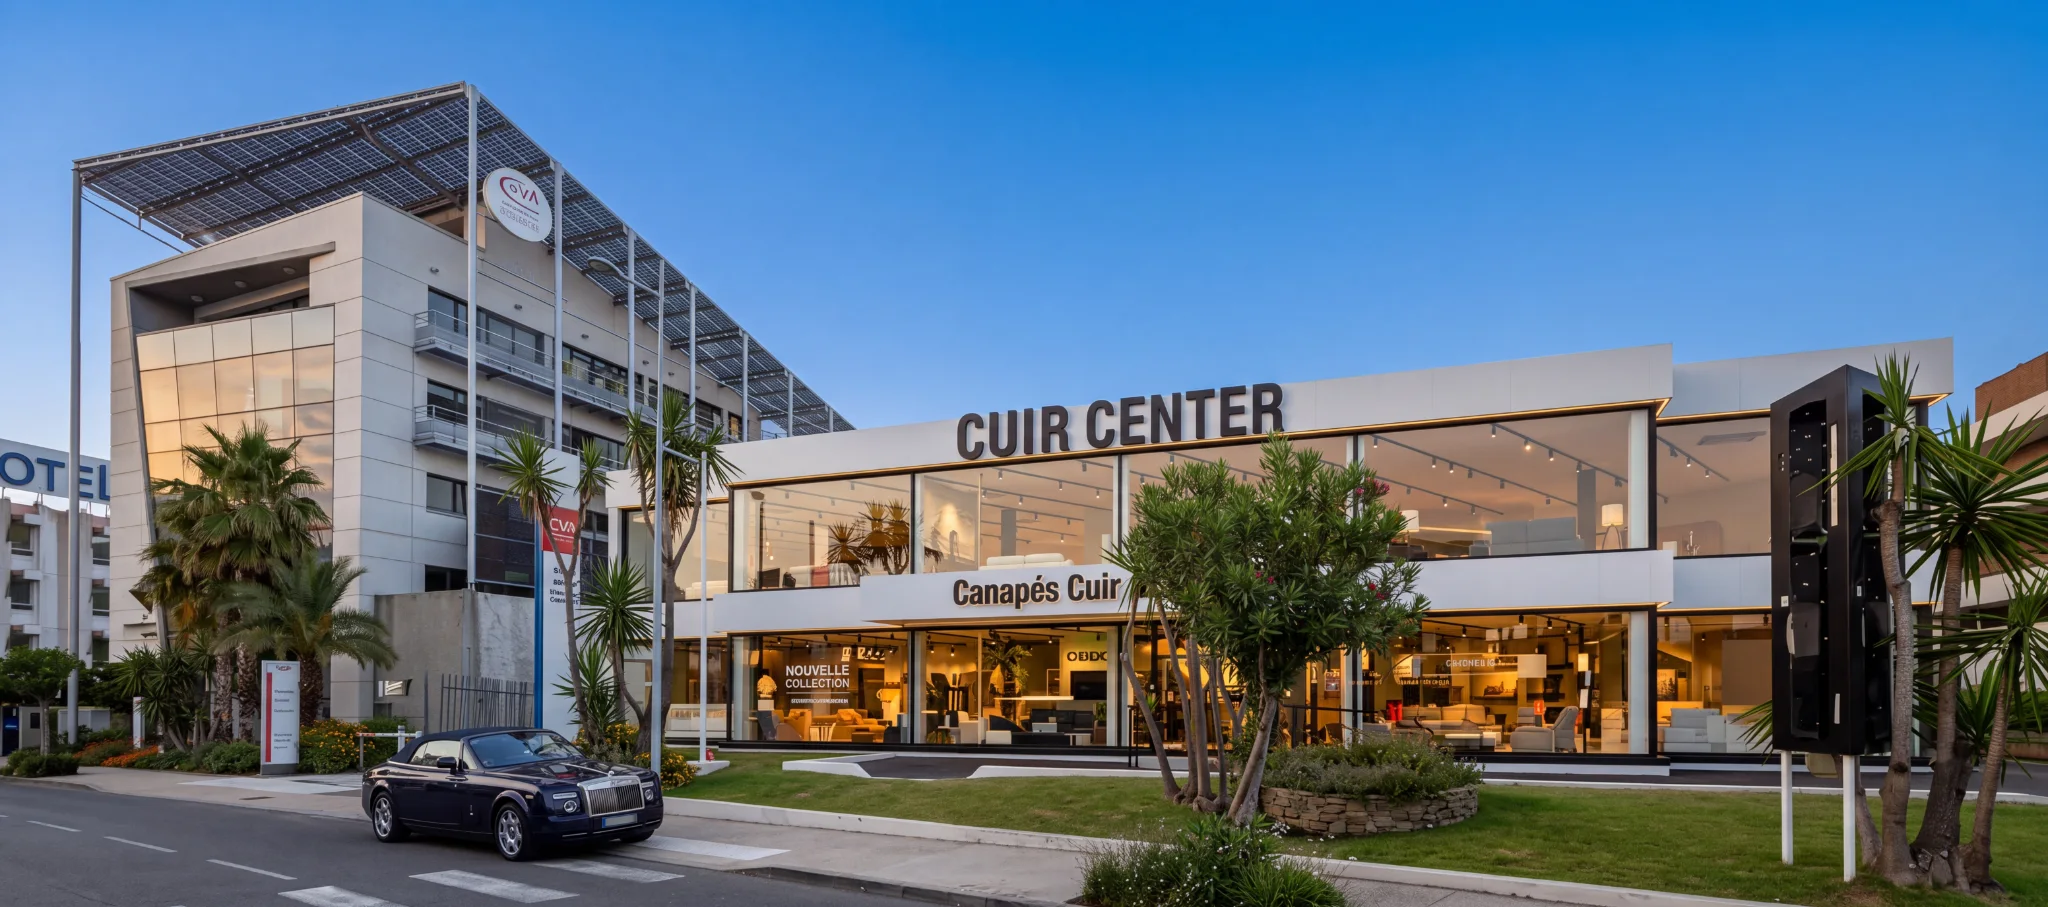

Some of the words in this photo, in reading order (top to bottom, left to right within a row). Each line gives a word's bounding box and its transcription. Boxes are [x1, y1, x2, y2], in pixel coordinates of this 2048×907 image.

[957, 405, 1070, 460] CUIR
[1086, 382, 1284, 449] CENTER
[953, 574, 1060, 610] Canapés
[1067, 572, 1122, 601] Cuir
[785, 665, 850, 676] NOUVELLE
[785, 678, 850, 689] COLLECTION
